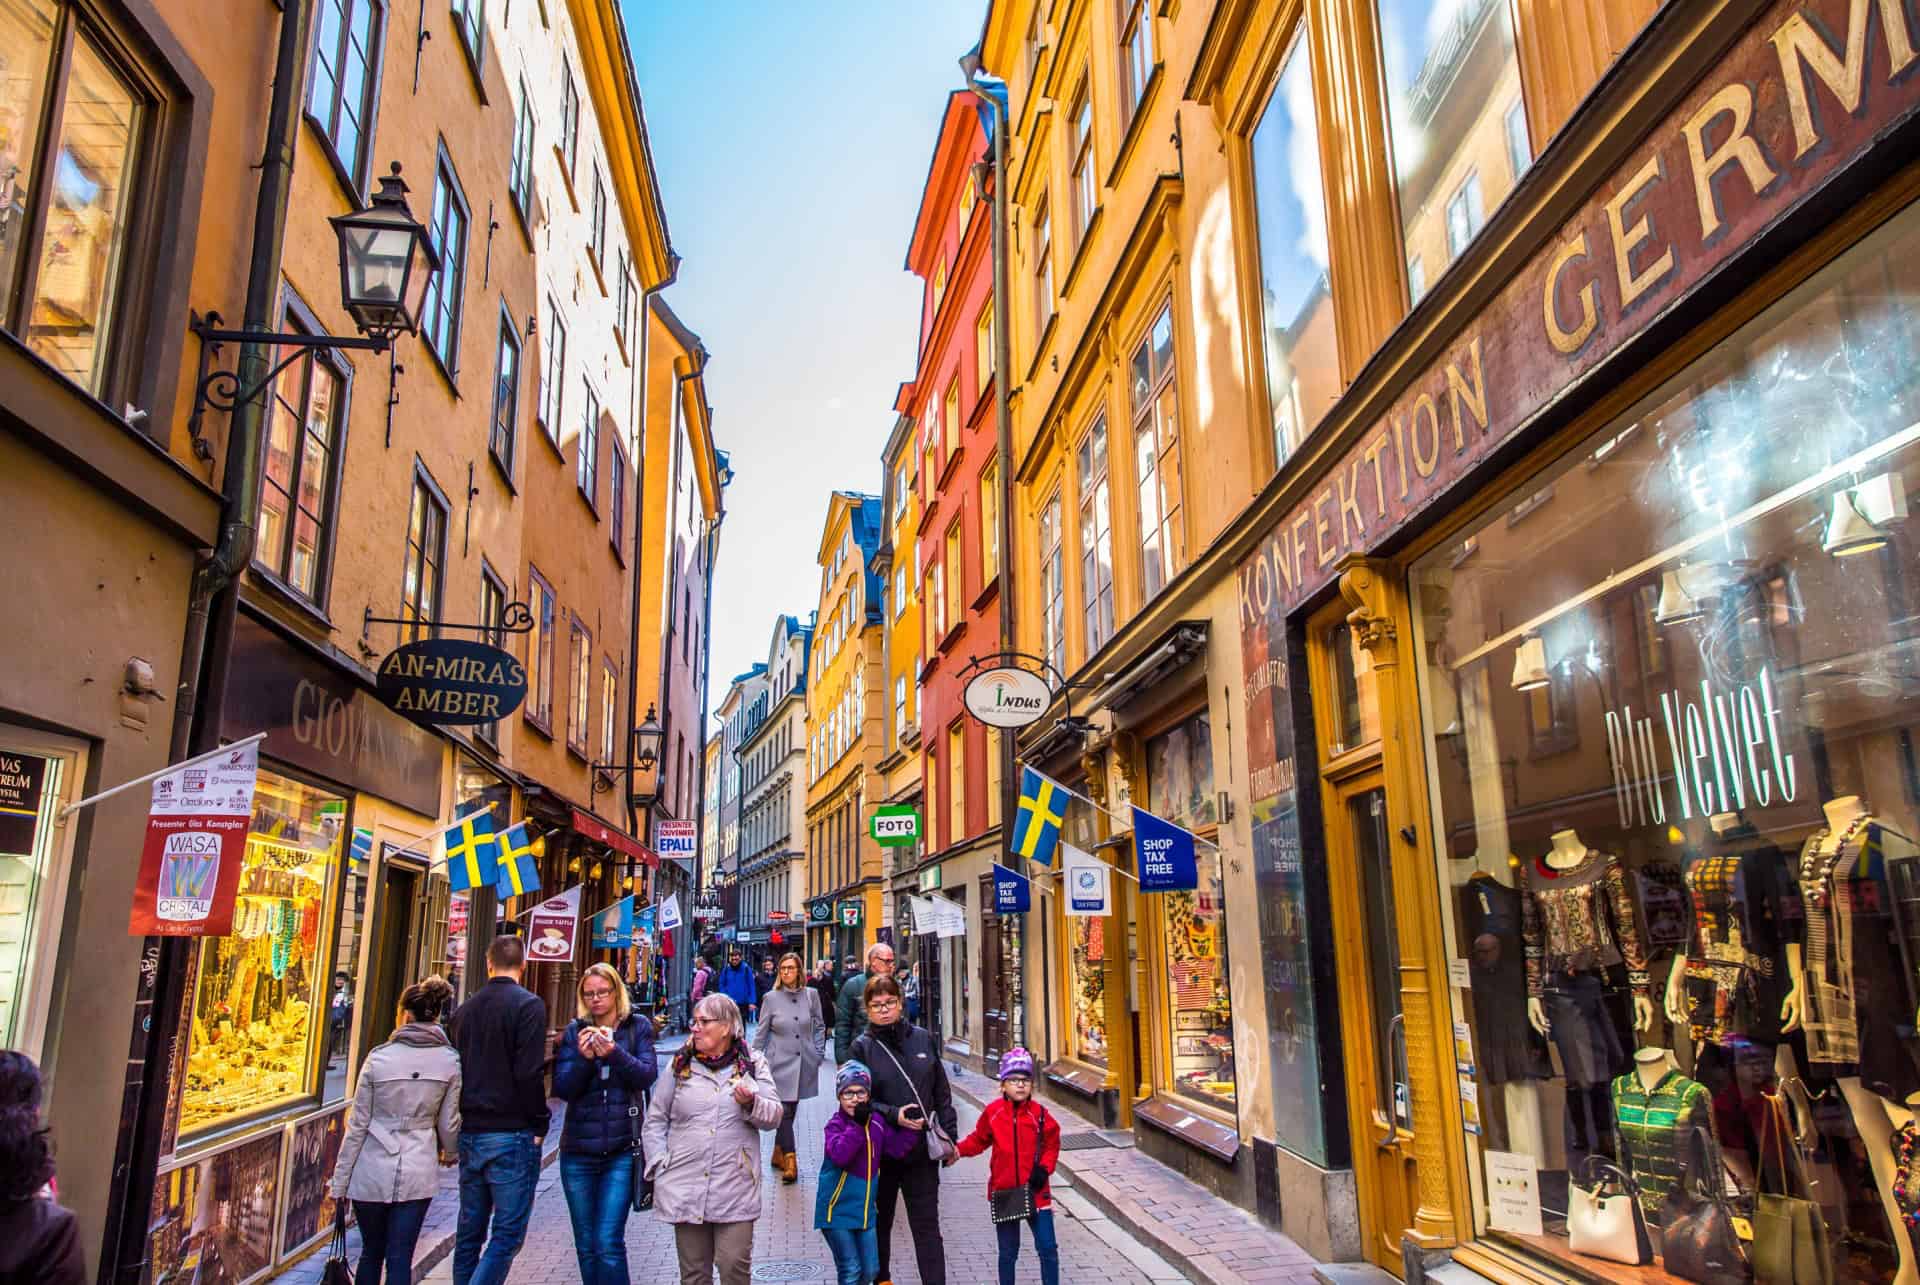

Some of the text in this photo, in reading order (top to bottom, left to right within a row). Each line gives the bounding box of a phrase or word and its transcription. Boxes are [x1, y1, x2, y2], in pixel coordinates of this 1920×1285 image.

[1238, 336, 1489, 632] KONFEKTION
[395, 687, 501, 717] AMBER
[1605, 665, 1796, 829] Blu Velvet
[152, 819, 186, 828] Presenter
[877, 819, 914, 832] FOTO
[170, 835, 218, 853] WASA
[659, 837, 695, 852] EPALL
[1143, 838, 1174, 850] SHOP
[1144, 851, 1167, 863] TAX
[1145, 863, 1174, 876] FREE
[998, 881, 1017, 889] SHOP
[999, 896, 1017, 904] FREE
